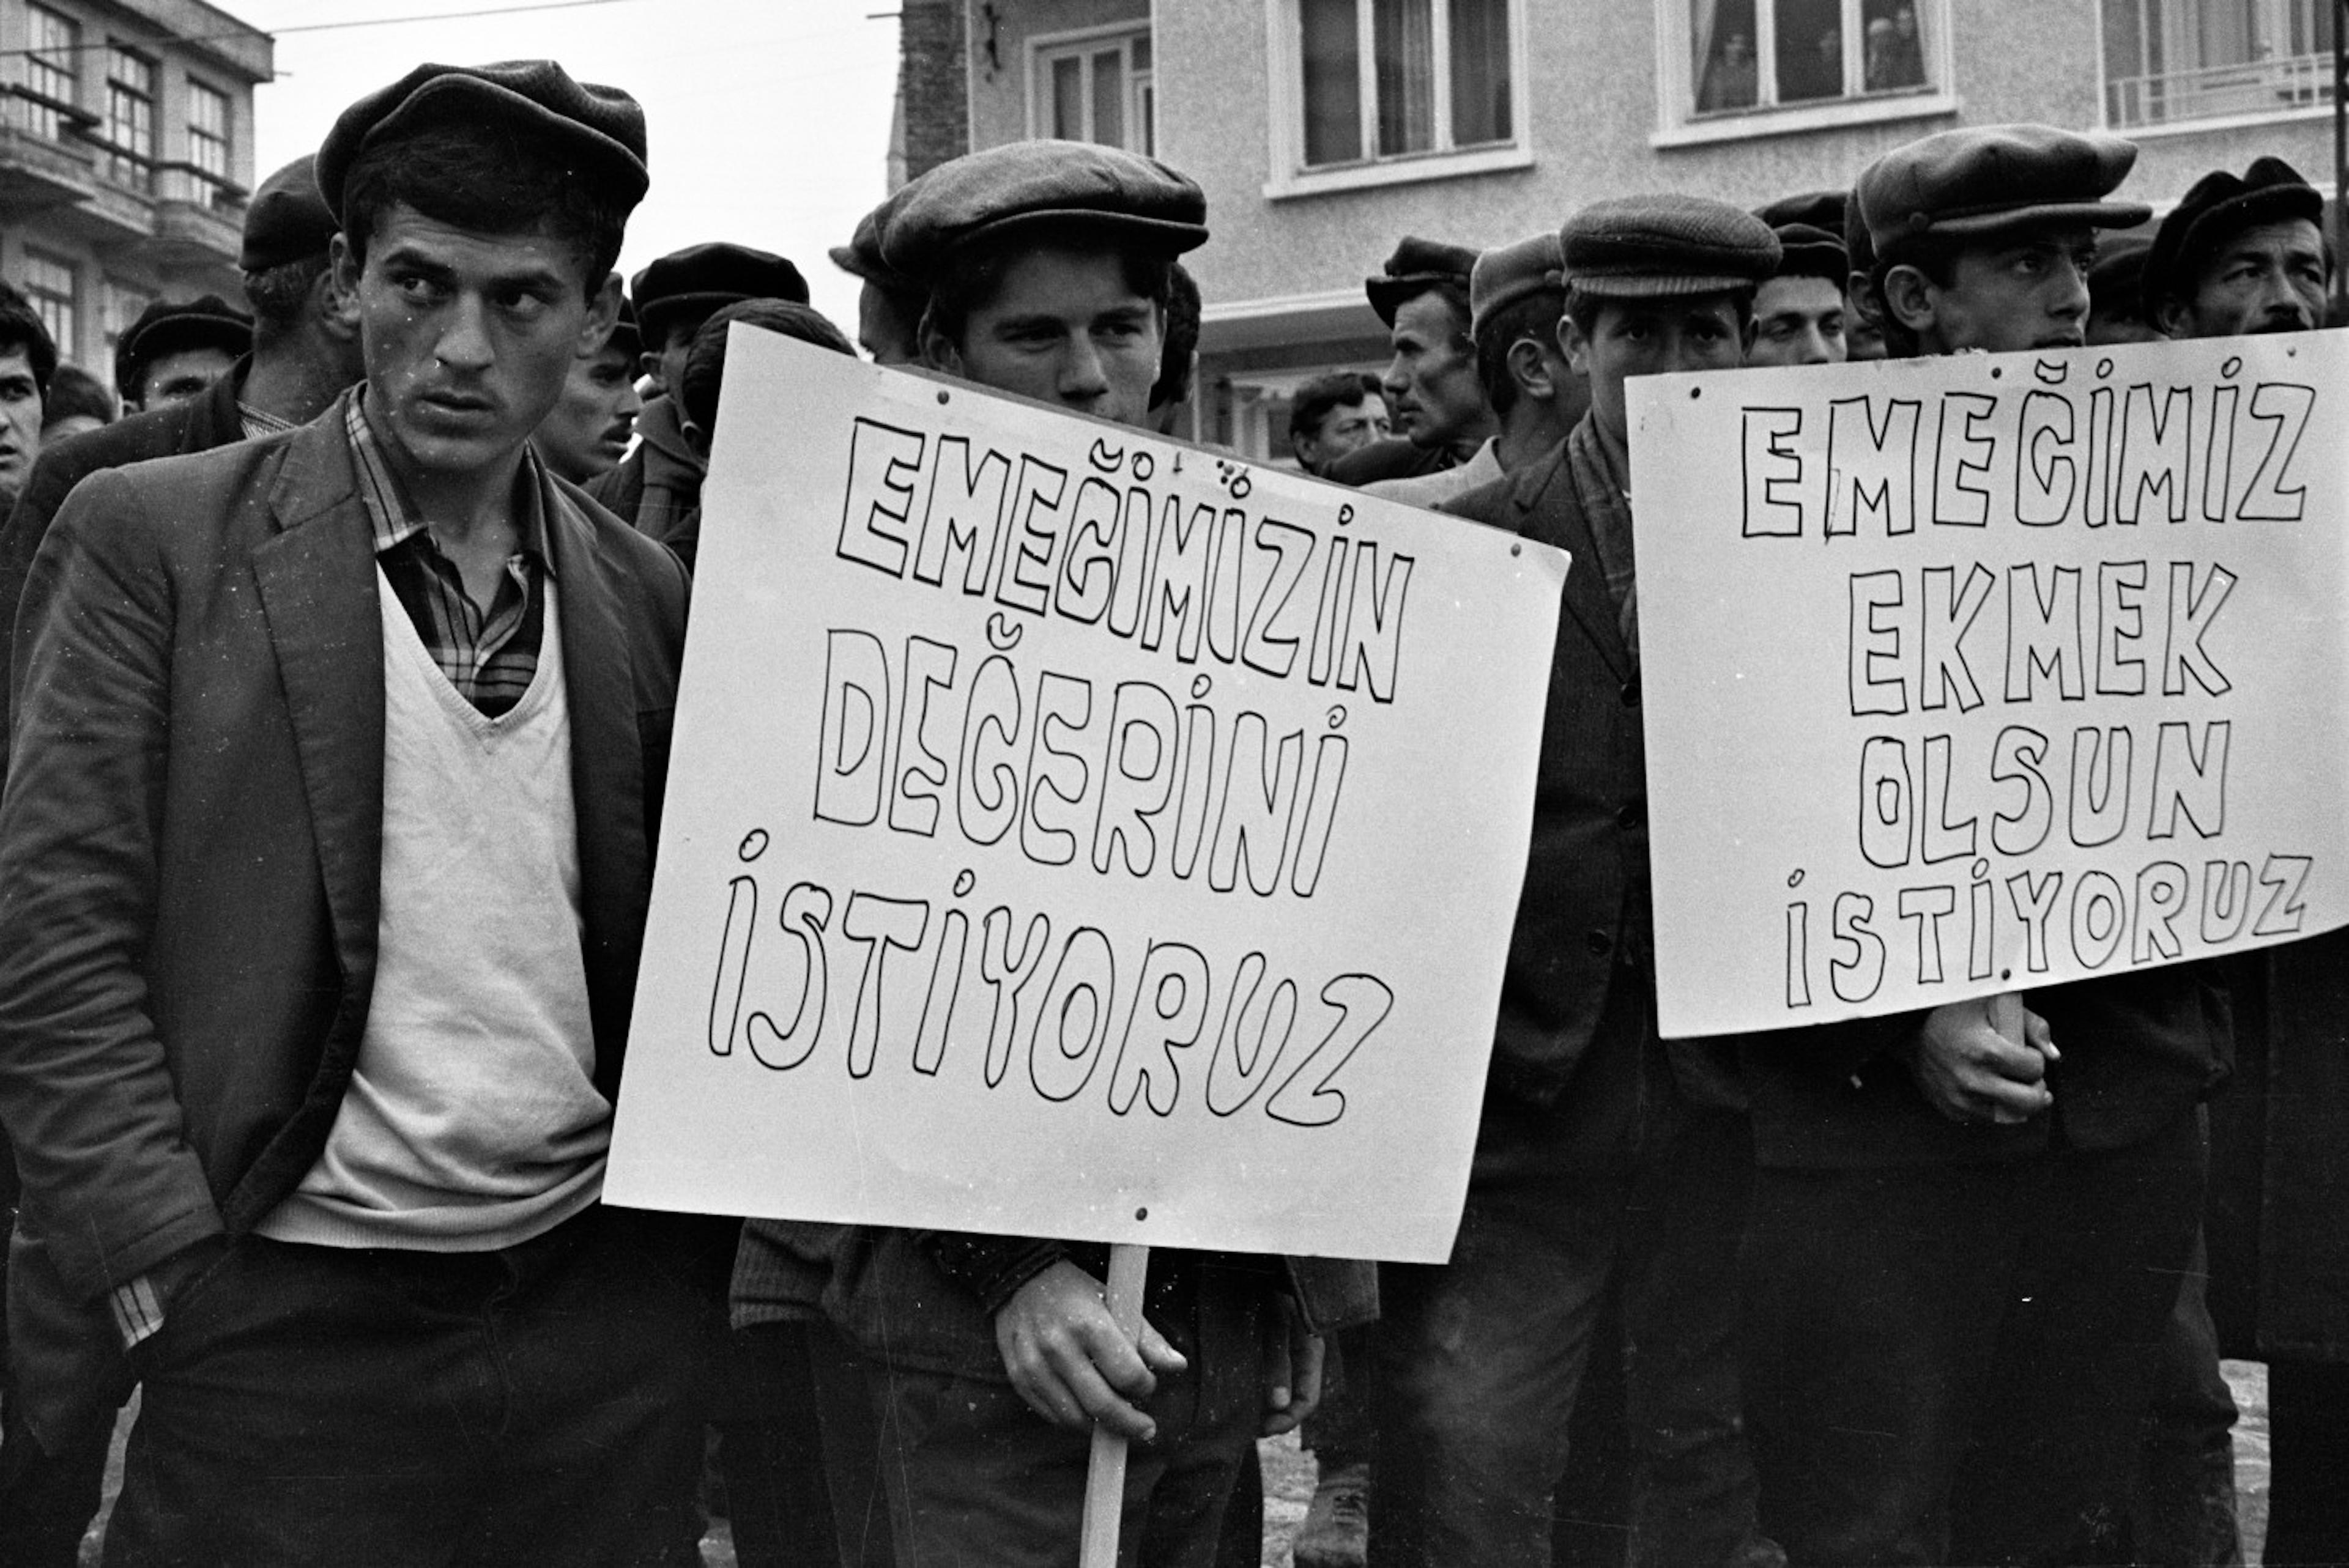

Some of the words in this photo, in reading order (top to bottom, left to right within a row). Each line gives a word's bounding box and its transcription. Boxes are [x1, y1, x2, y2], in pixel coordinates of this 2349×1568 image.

[1741, 357, 2316, 542] EMEĞİMİZ
[836, 416, 1414, 704] EMEĞİMİZİN
[1848, 560, 2238, 716] EKMEK
[814, 612, 1348, 898] DEĞERİNİ
[1858, 720, 2231, 869] OLSUN
[709, 829, 1394, 1127] İSTİYORUZ
[1786, 854, 2314, 1008] İSTİYORUZ
